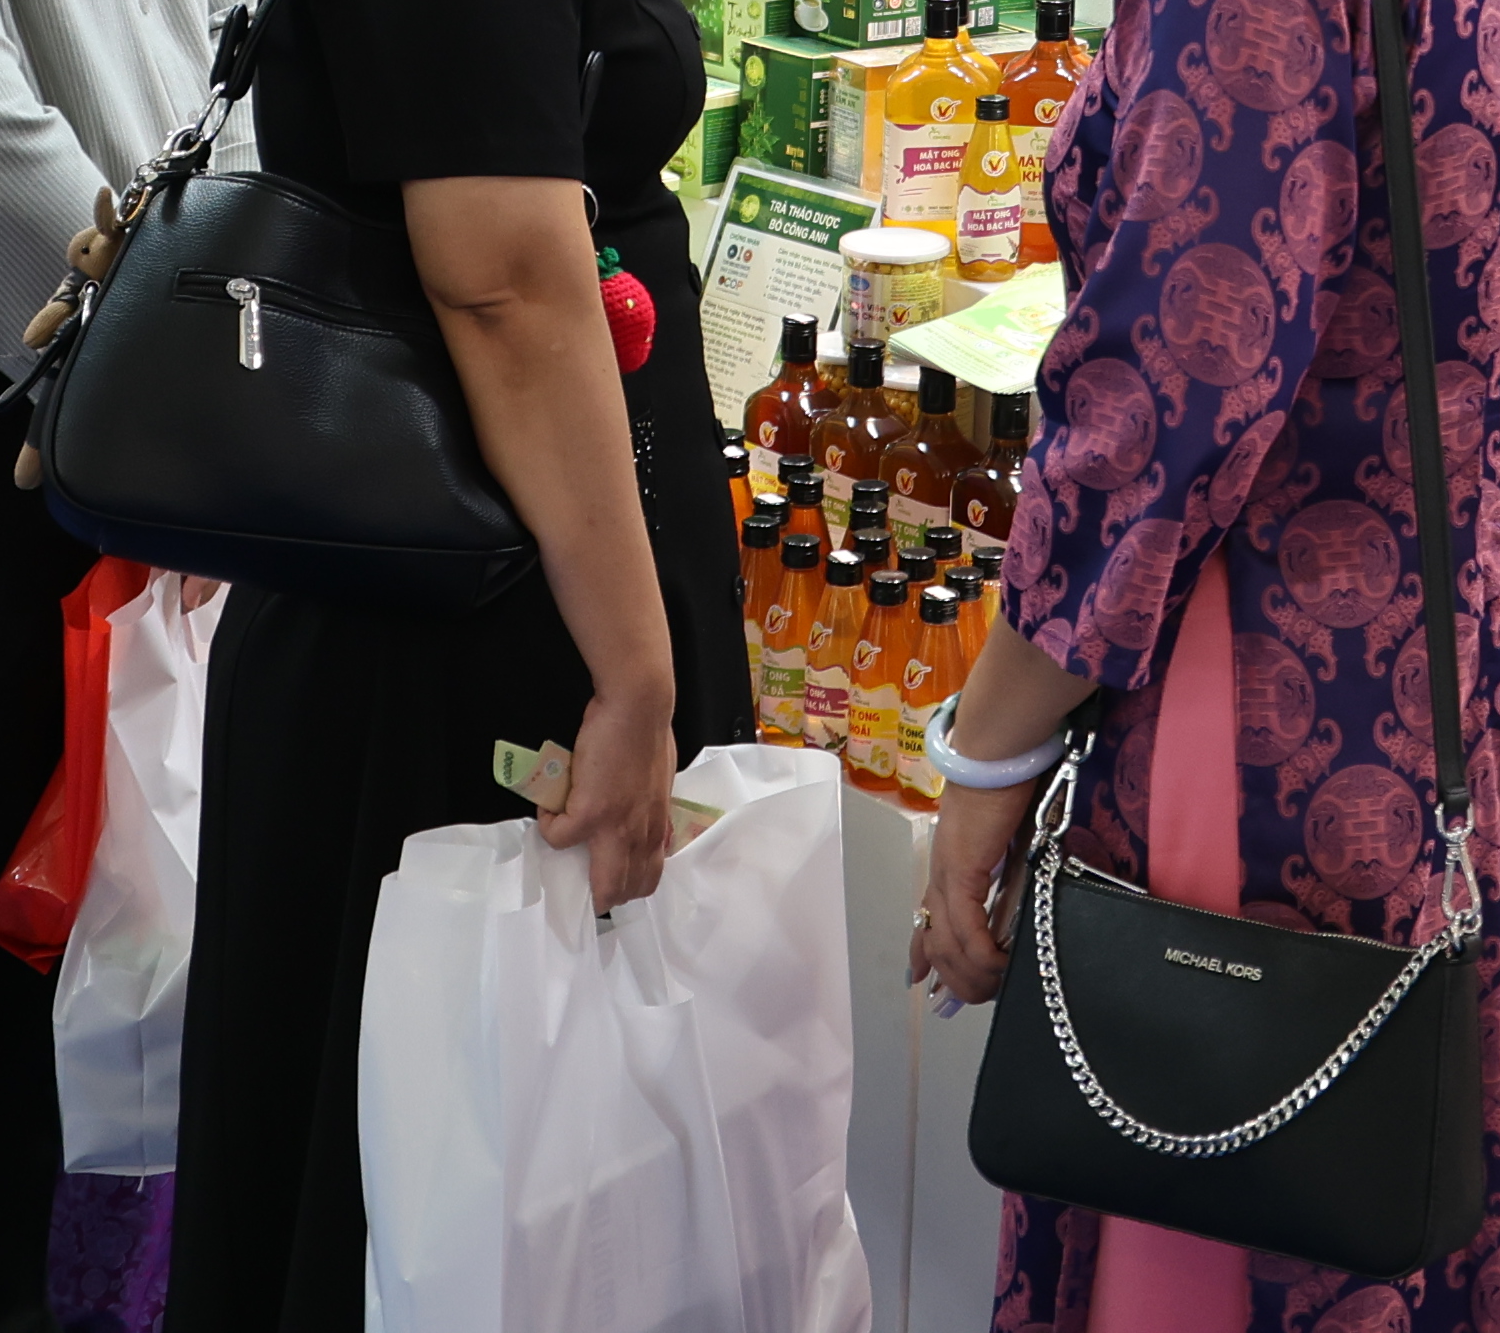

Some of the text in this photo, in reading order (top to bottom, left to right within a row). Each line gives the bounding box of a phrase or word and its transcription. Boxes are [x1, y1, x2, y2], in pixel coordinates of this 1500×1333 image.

[770, 199, 840, 229] TRÀ THẢO DƯỢC
[782, 219, 806, 240] CÔNG
[806, 229, 828, 245] ANH
[1164, 947, 1262, 982] MICHAEL KORS
